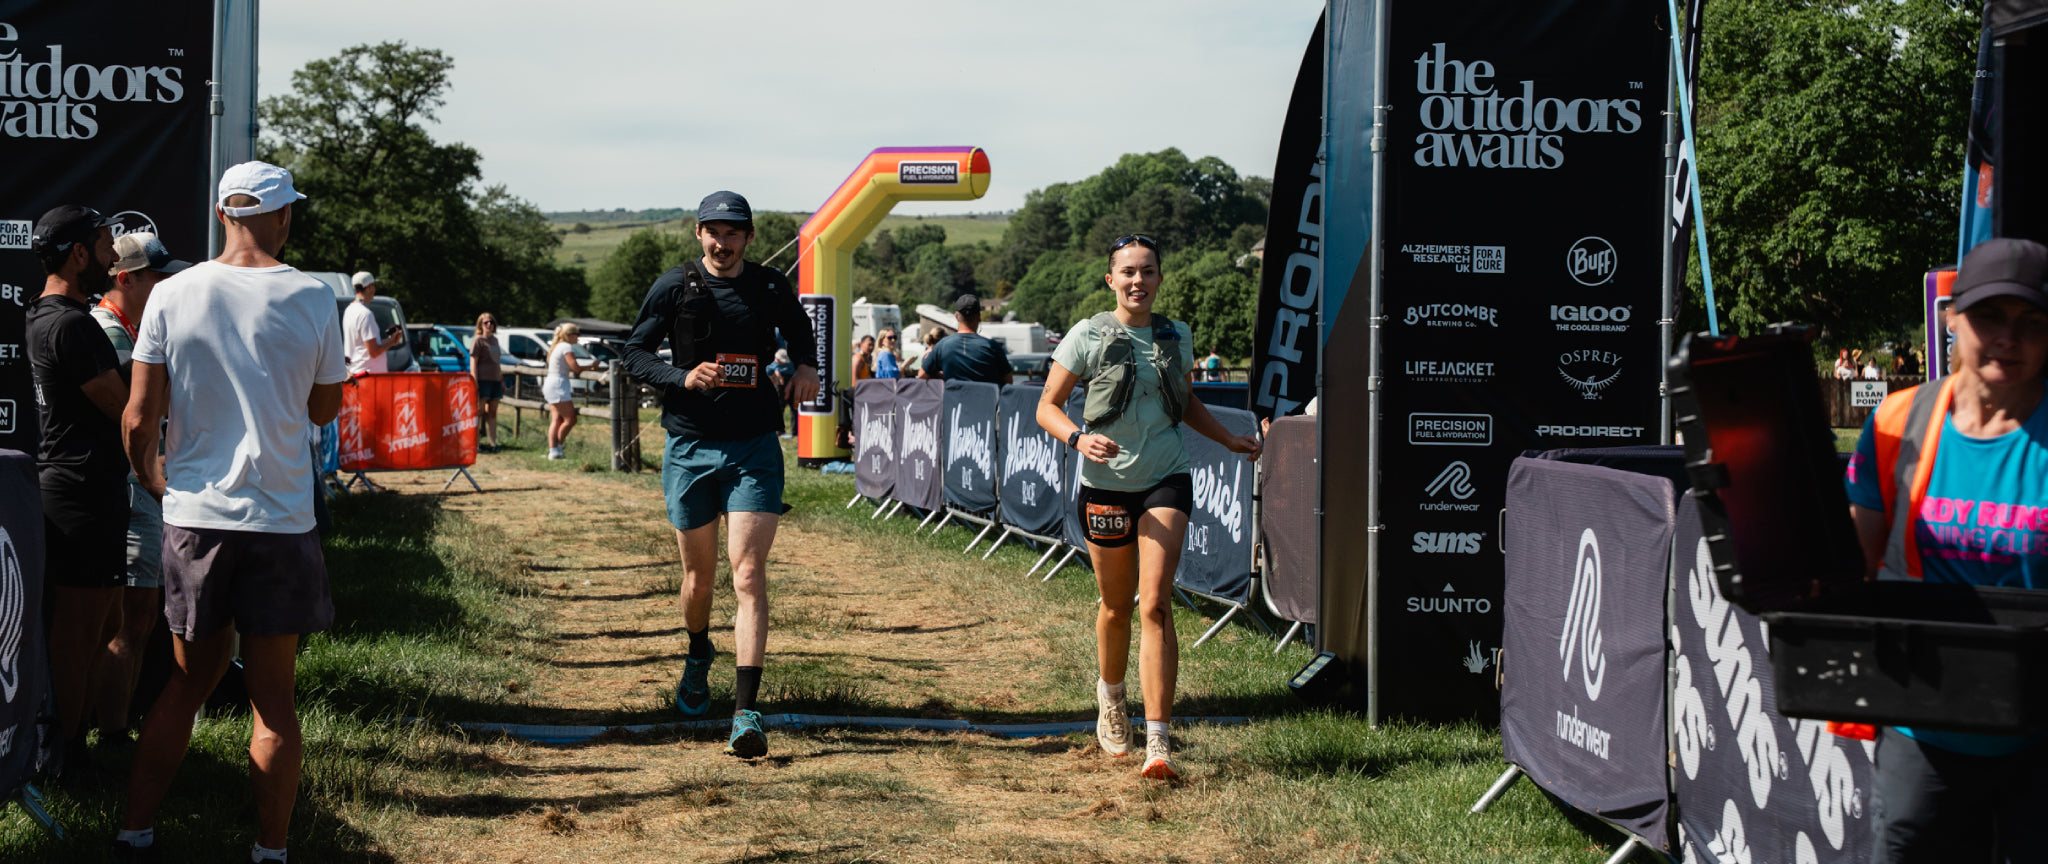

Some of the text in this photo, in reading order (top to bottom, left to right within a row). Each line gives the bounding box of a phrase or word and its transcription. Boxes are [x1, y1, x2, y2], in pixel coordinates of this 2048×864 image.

[1414, 42, 1495, 96] the
[1420, 80, 1642, 134] outdoors
[0, 94, 99, 140] aits
[1414, 127, 1565, 170] awaits
[903, 165, 955, 175] PRECISION
[21, 223, 29, 234] A
[1401, 244, 1471, 254] ALZHEIMER'S
[1476, 249, 1502, 259] FOR A
[1413, 253, 1471, 264] RESEARCH
[1476, 260, 1502, 271] CURE
[1455, 263, 1471, 273] UK
[1403, 303, 1499, 327] BUTCOMBE
[1550, 304, 1631, 322] IGLOO
[816, 304, 827, 364] HYDRATION
[1556, 323, 1570, 331] THE
[1601, 324, 1627, 332] BRAND
[1560, 350, 1623, 367] OSPREY
[1415, 420, 1486, 431] PRECISION
[1535, 425, 1645, 438] PRO:DIRECT
[1443, 431, 1486, 439] HYDRATION
[1420, 501, 1481, 511] runderwear
[1090, 514, 1124, 529] 1316
[1188, 522, 1209, 556] RACE
[1411, 531, 1482, 554] sums
[1407, 597, 1491, 614] SUUNTO
[1556, 704, 1611, 760] runderwear
